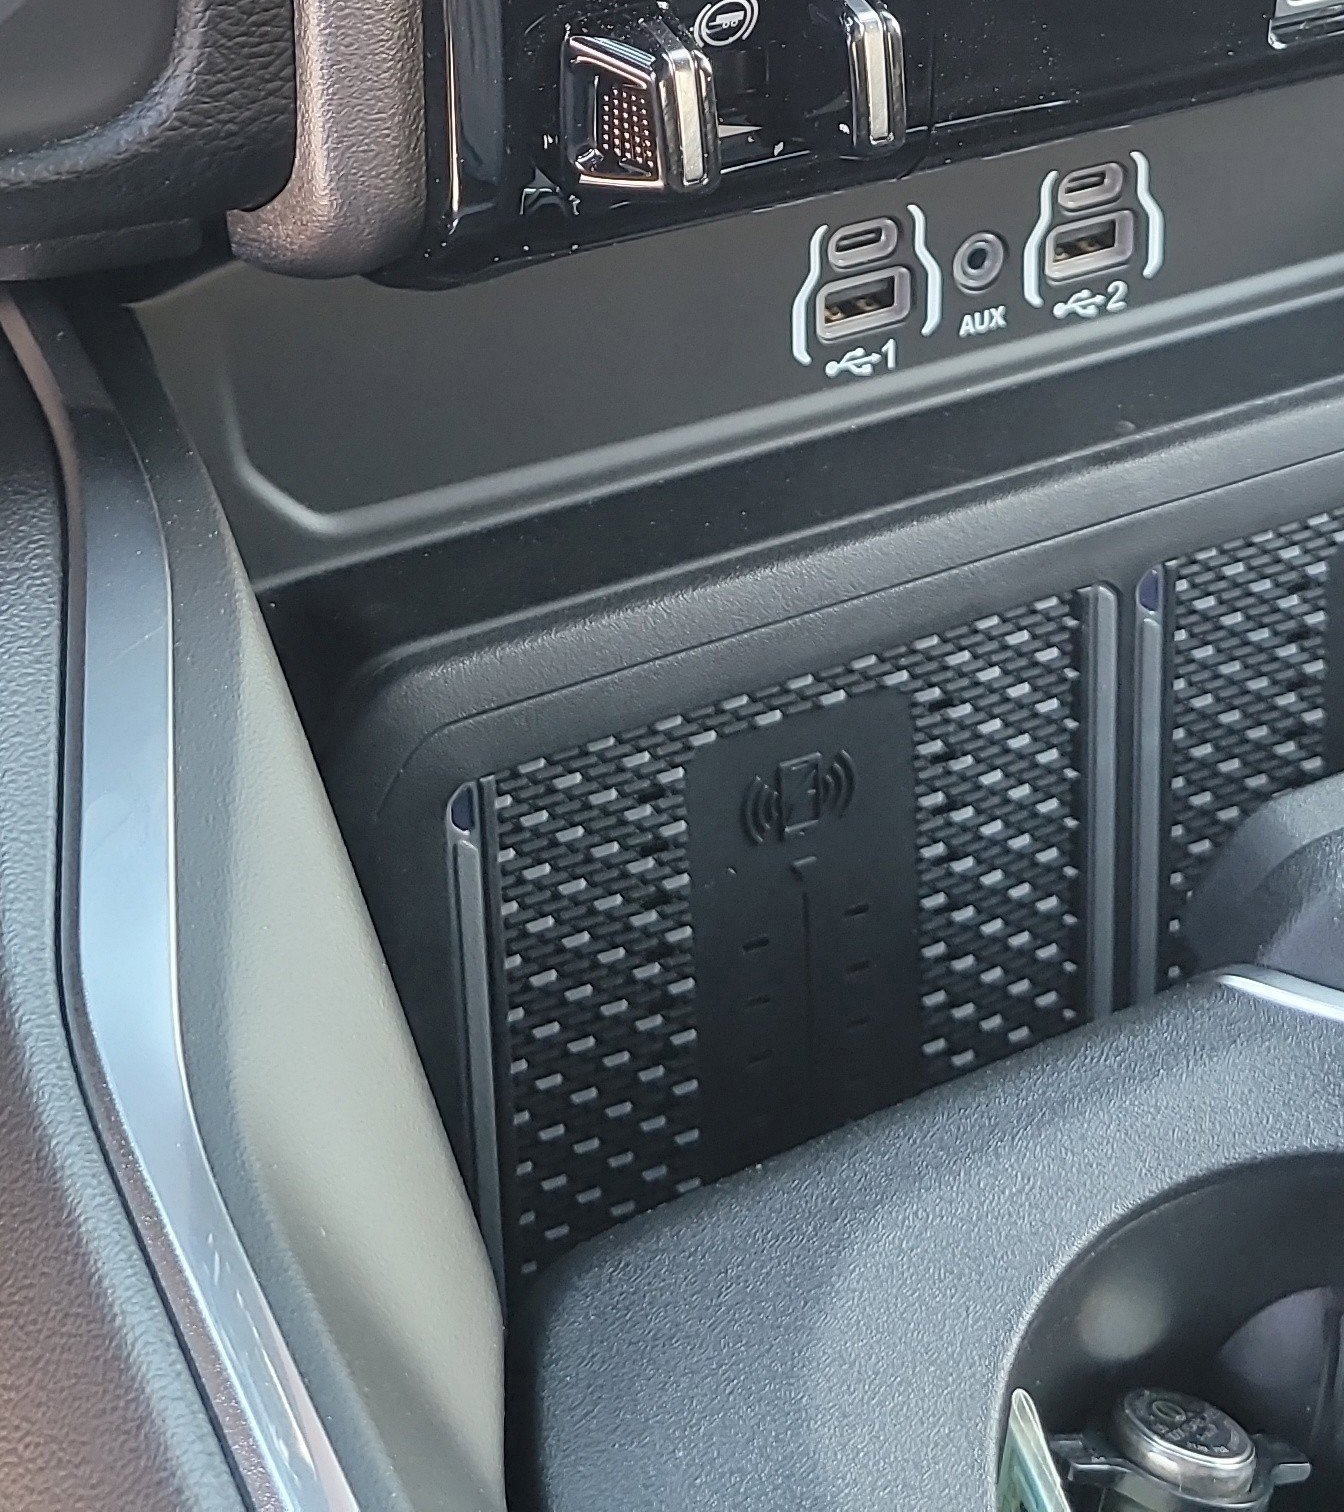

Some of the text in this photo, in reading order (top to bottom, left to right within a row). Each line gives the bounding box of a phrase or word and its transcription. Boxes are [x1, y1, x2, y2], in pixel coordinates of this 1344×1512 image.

[1107, 281, 1127, 312] 2
[959, 306, 1007, 337] AUX
[881, 339, 897, 370] 1
